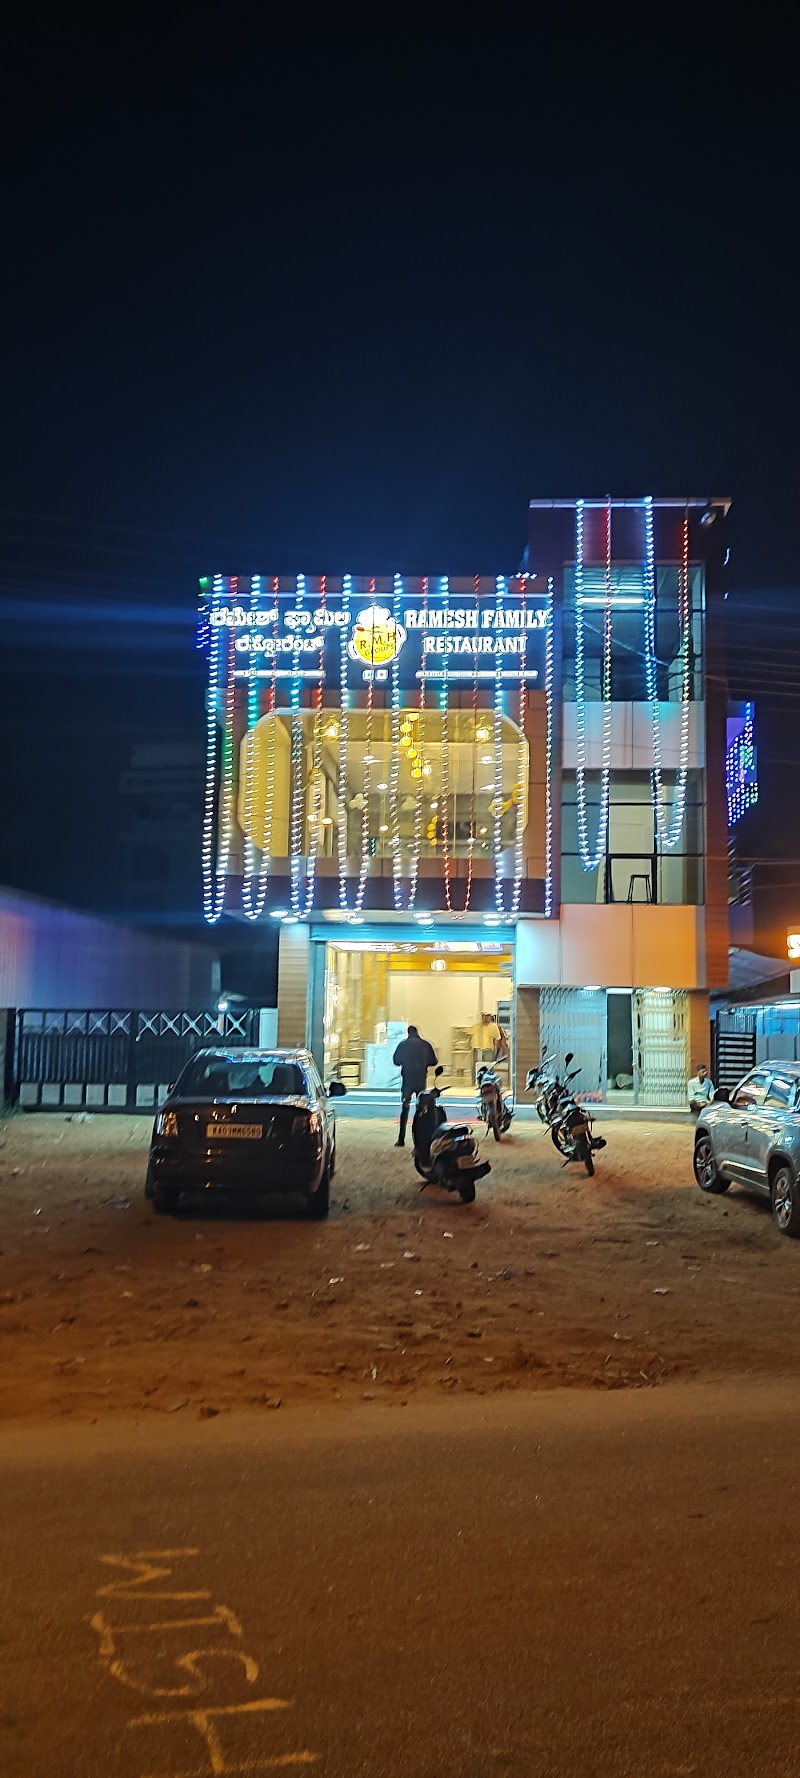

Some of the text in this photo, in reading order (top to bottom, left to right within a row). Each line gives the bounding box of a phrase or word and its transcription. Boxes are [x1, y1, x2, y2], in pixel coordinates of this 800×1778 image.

[404, 610, 549, 628] RAMESH FAMILY
[364, 643, 395, 656] GOUPS
[423, 636, 528, 653] RESTAURANT
